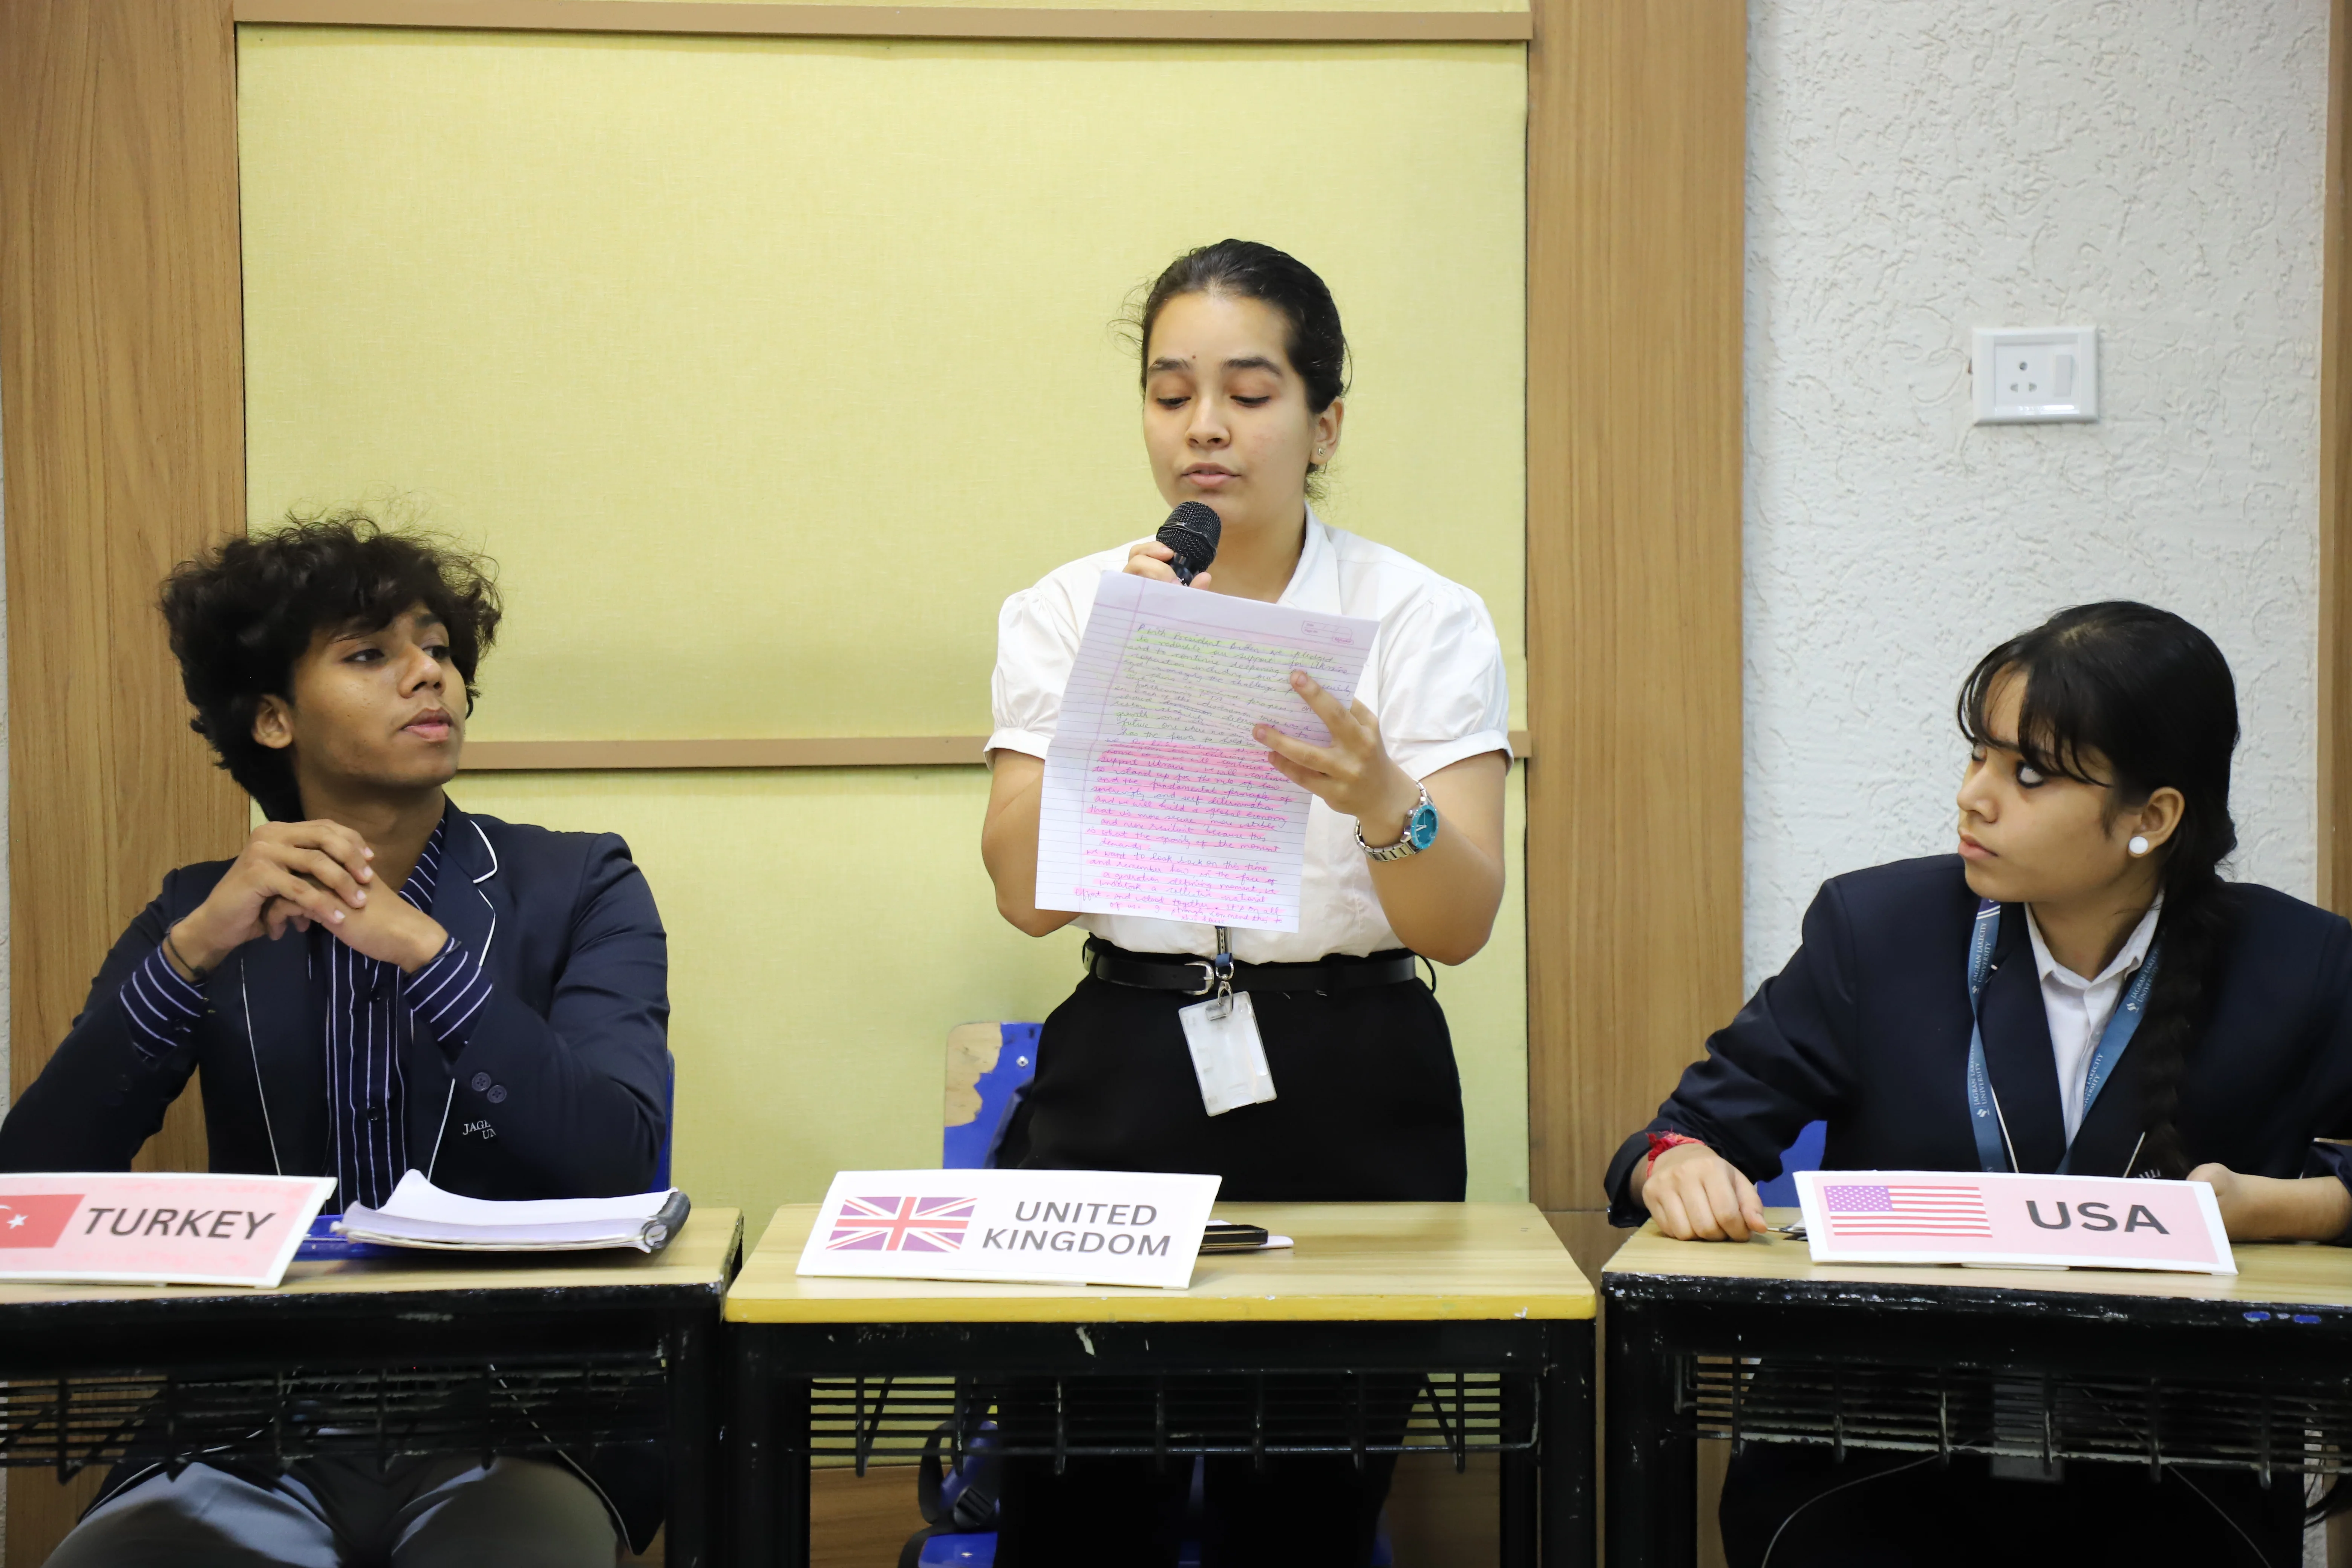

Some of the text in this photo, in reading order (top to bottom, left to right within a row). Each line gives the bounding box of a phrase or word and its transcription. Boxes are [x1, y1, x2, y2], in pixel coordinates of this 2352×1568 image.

[1234, 653, 1273, 665] support
[1097, 756, 1138, 767] support
[1157, 773, 1170, 781] up
[1239, 781, 1255, 790] of
[1089, 804, 1115, 813] that
[1095, 796, 1115, 805] and
[1159, 799, 1185, 812] build
[1280, 796, 1292, 805] of
[1102, 828, 1129, 838] what
[1135, 831, 1152, 840] the
[1196, 840, 1208, 848] of
[1214, 840, 1235, 848] the
[1104, 851, 1127, 859] want
[1134, 852, 1145, 860] to
[1150, 853, 1173, 864] look
[1245, 862, 1268, 872] time
[1116, 862, 1162, 874] remember
[1200, 870, 1211, 878] in
[1110, 901, 1122, 911] of
[1273, 916, 1283, 924] to
[1263, 906, 1282, 916] all
[1972, 922, 1987, 982] JAGRAN LAKECITY
[1978, 942, 1992, 983] UNIVERSITY
[2131, 974, 2147, 1000] JAGRAN
[1971, 1078, 1981, 1106] JAGRAN
[1975, 1063, 1988, 1105] UNIVERSITY
[85, 1208, 277, 1240] TURKEY
[1015, 1200, 1158, 1227] UNITED
[2025, 1200, 2170, 1234] USA
[982, 1228, 1171, 1257] KINGDOM
